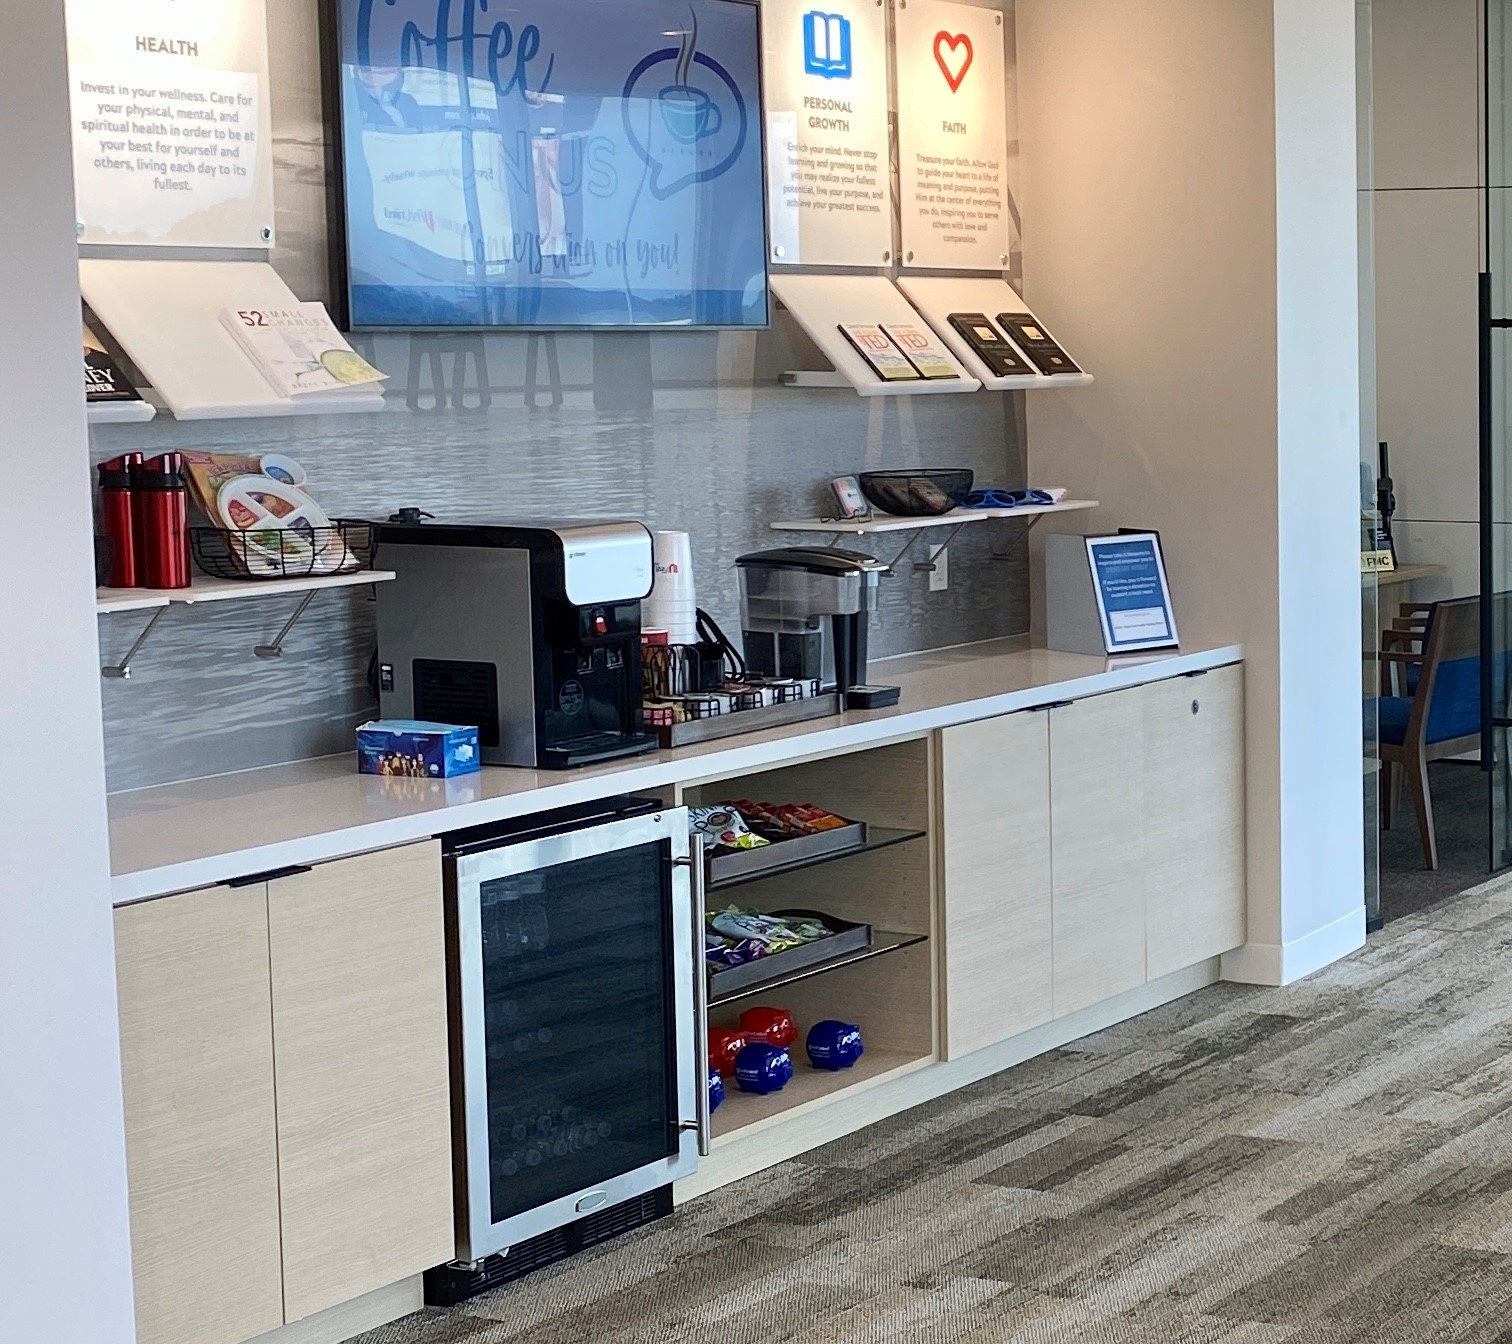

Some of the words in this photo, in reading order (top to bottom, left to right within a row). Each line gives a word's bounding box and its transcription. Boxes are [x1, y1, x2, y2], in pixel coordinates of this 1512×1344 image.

[136, 36, 198, 56] HEALTH
[80, 81, 115, 94] Invest
[118, 84, 129, 95] in
[132, 87, 156, 98] your
[159, 89, 208, 102] wellness.
[210, 92, 234, 104] Care
[237, 93, 253, 106] for
[97, 103, 122, 115] your
[126, 104, 174, 120] physical,
[177, 109, 217, 123] mental,
[220, 111, 239, 122] and
[803, 96, 853, 113] PERSONAL
[81, 119, 129, 133] spiritual
[132, 121, 167, 135] health
[170, 125, 180, 136] in
[182, 125, 212, 138] order
[214, 128, 225, 139] to
[228, 128, 241, 140] be
[244, 131, 255, 141] at
[808, 116, 850, 132] GROWTH
[942, 120, 967, 134] FAITH
[100, 140, 125, 152] your
[128, 140, 153, 152] best
[155, 141, 171, 153] for
[174, 143, 217, 157] yourself
[220, 146, 240, 158] and
[94, 157, 135, 171] others,
[137, 159, 167, 174] living
[170, 162, 195, 173] each
[198, 163, 216, 176] day
[219, 165, 230, 175] to
[233, 165, 247, 176] its
[154, 177, 192, 191] fullest.
[238, 310, 268, 327] 52
[85, 367, 115, 384] NEY
[86, 383, 115, 392] OVER
